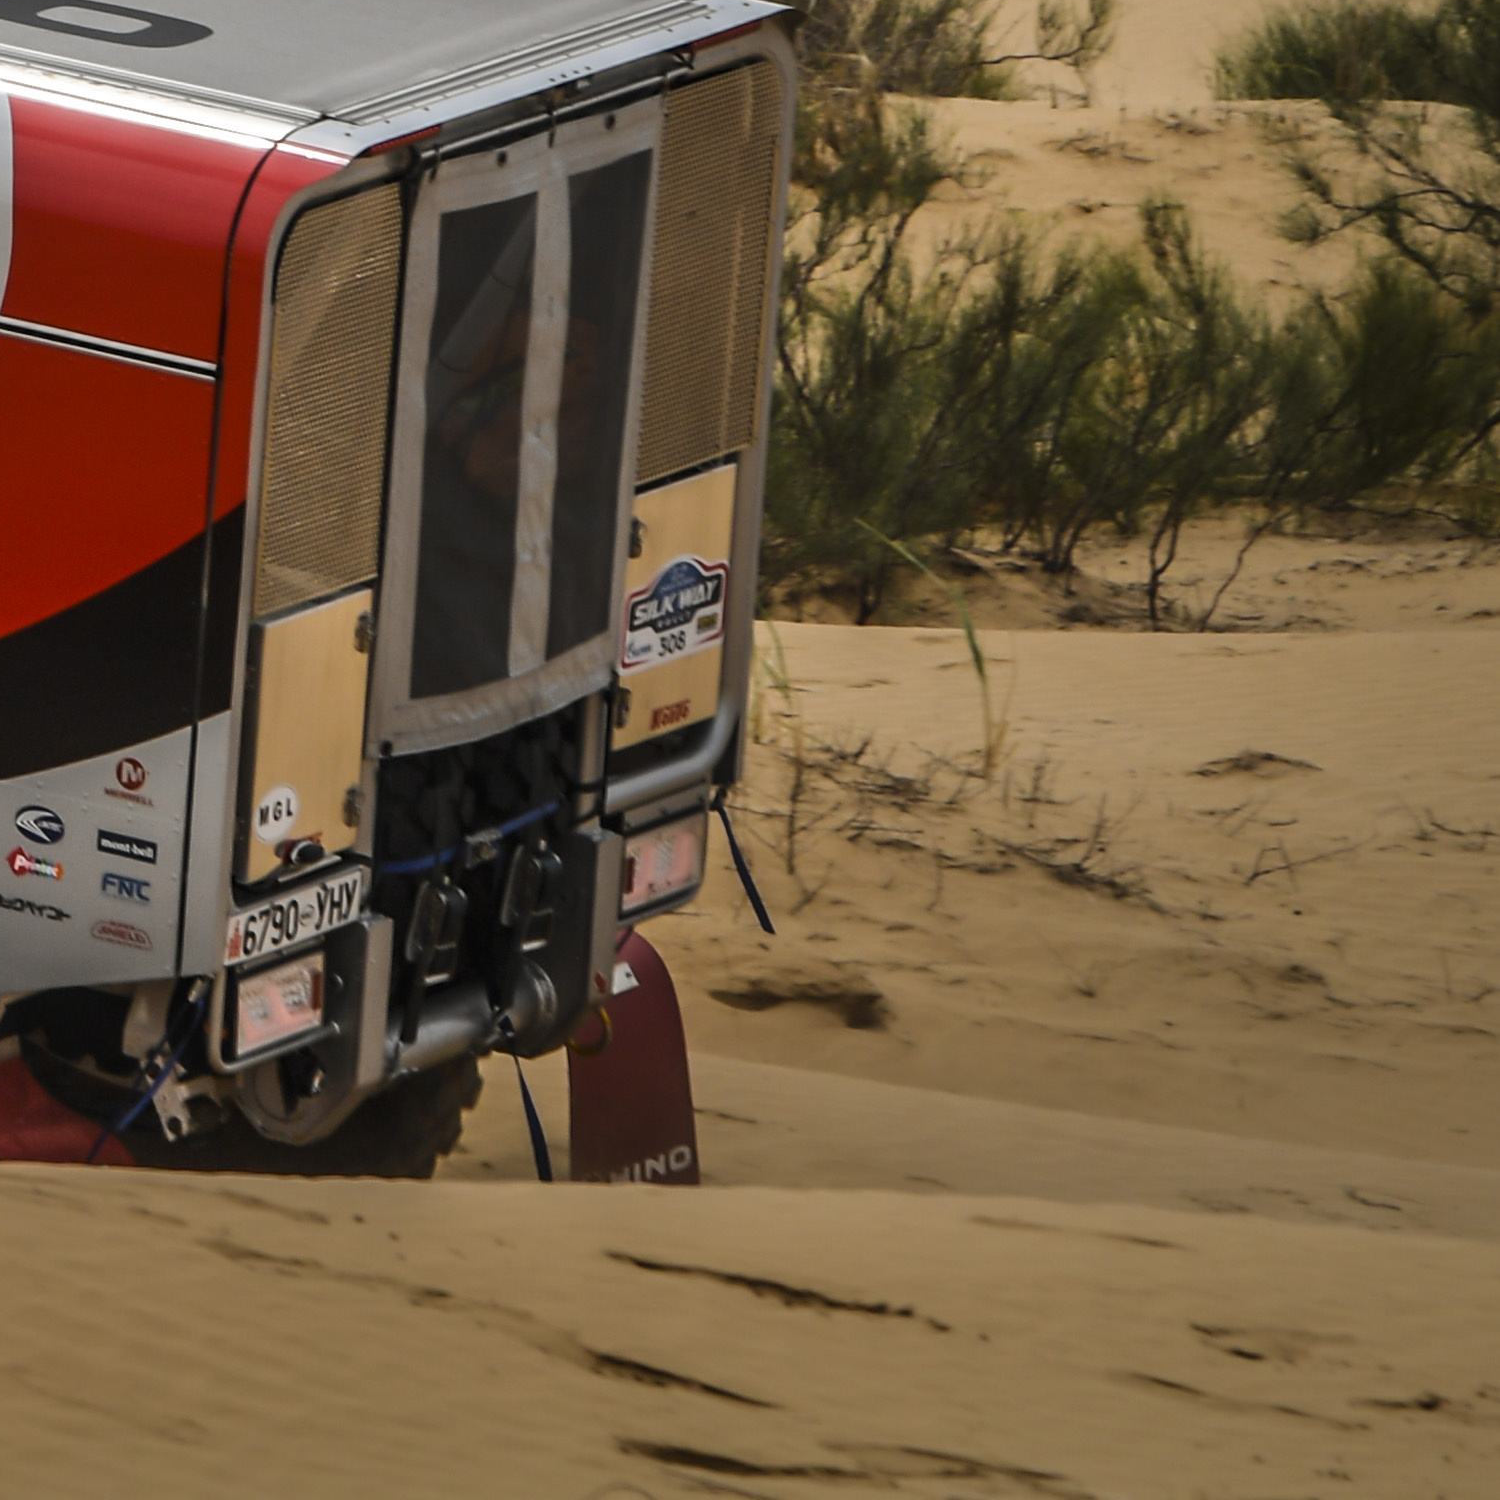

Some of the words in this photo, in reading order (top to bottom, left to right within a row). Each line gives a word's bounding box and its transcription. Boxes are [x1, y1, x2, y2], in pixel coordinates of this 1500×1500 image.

[633, 592, 675, 627] SILK
[679, 578, 719, 610] WAY
[258, 797, 294, 827] MGL
[242, 898, 300, 956] 6790
